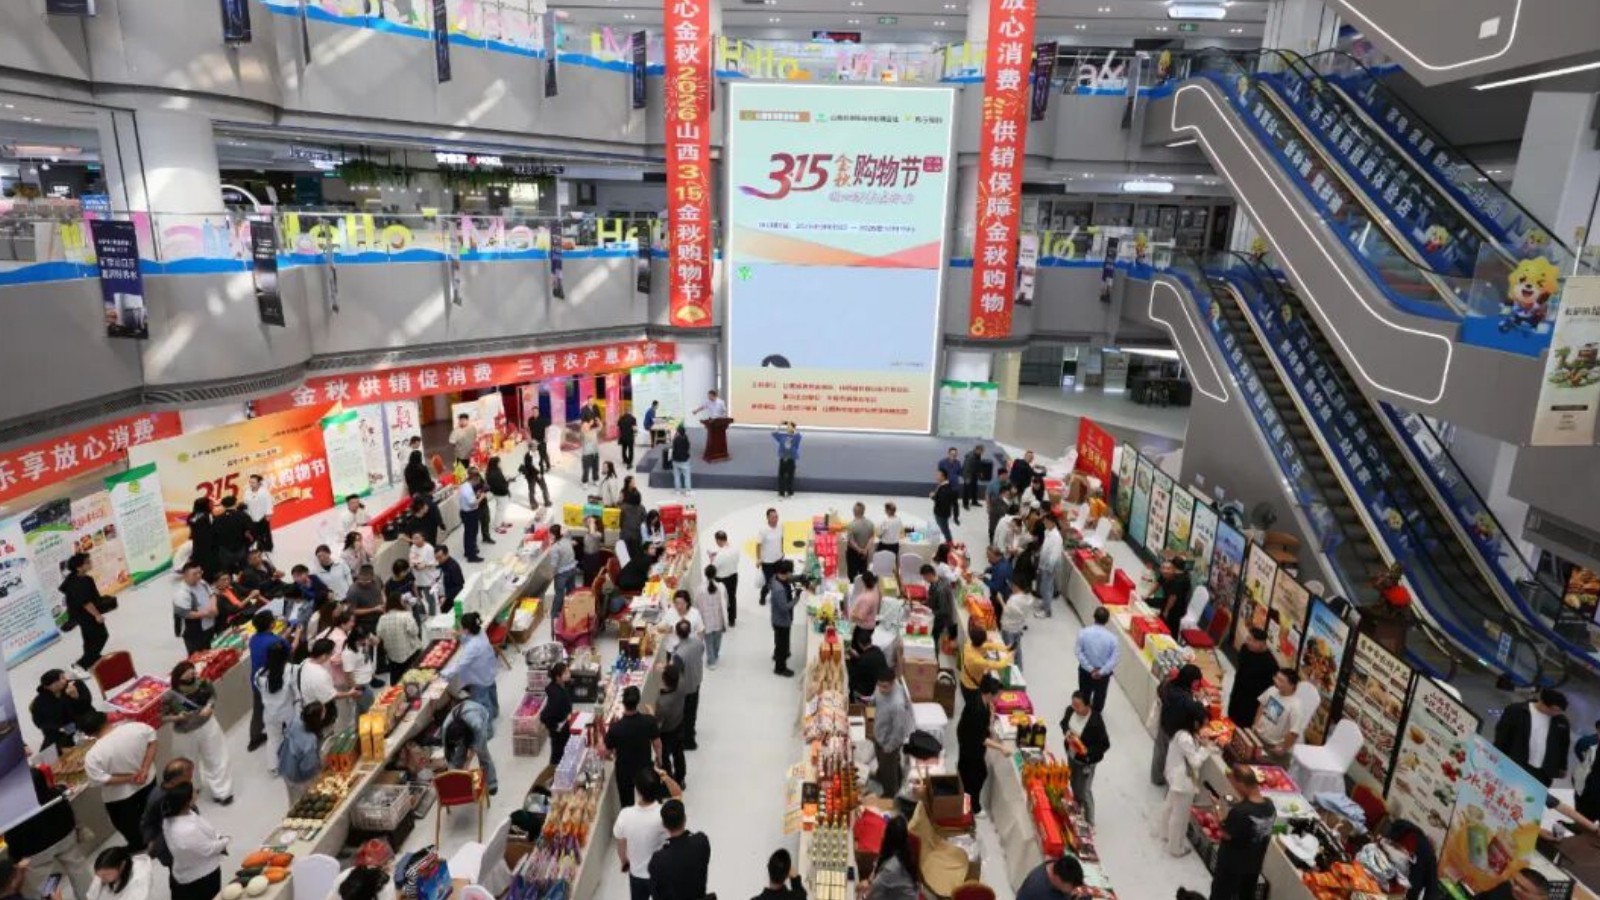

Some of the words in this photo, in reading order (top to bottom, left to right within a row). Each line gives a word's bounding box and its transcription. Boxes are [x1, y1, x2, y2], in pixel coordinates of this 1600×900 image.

[853, 153, 921, 188] 购物节
[291, 363, 494, 406] 金秋供销促消费
[517, 342, 660, 377] 三晋农产惠万家
